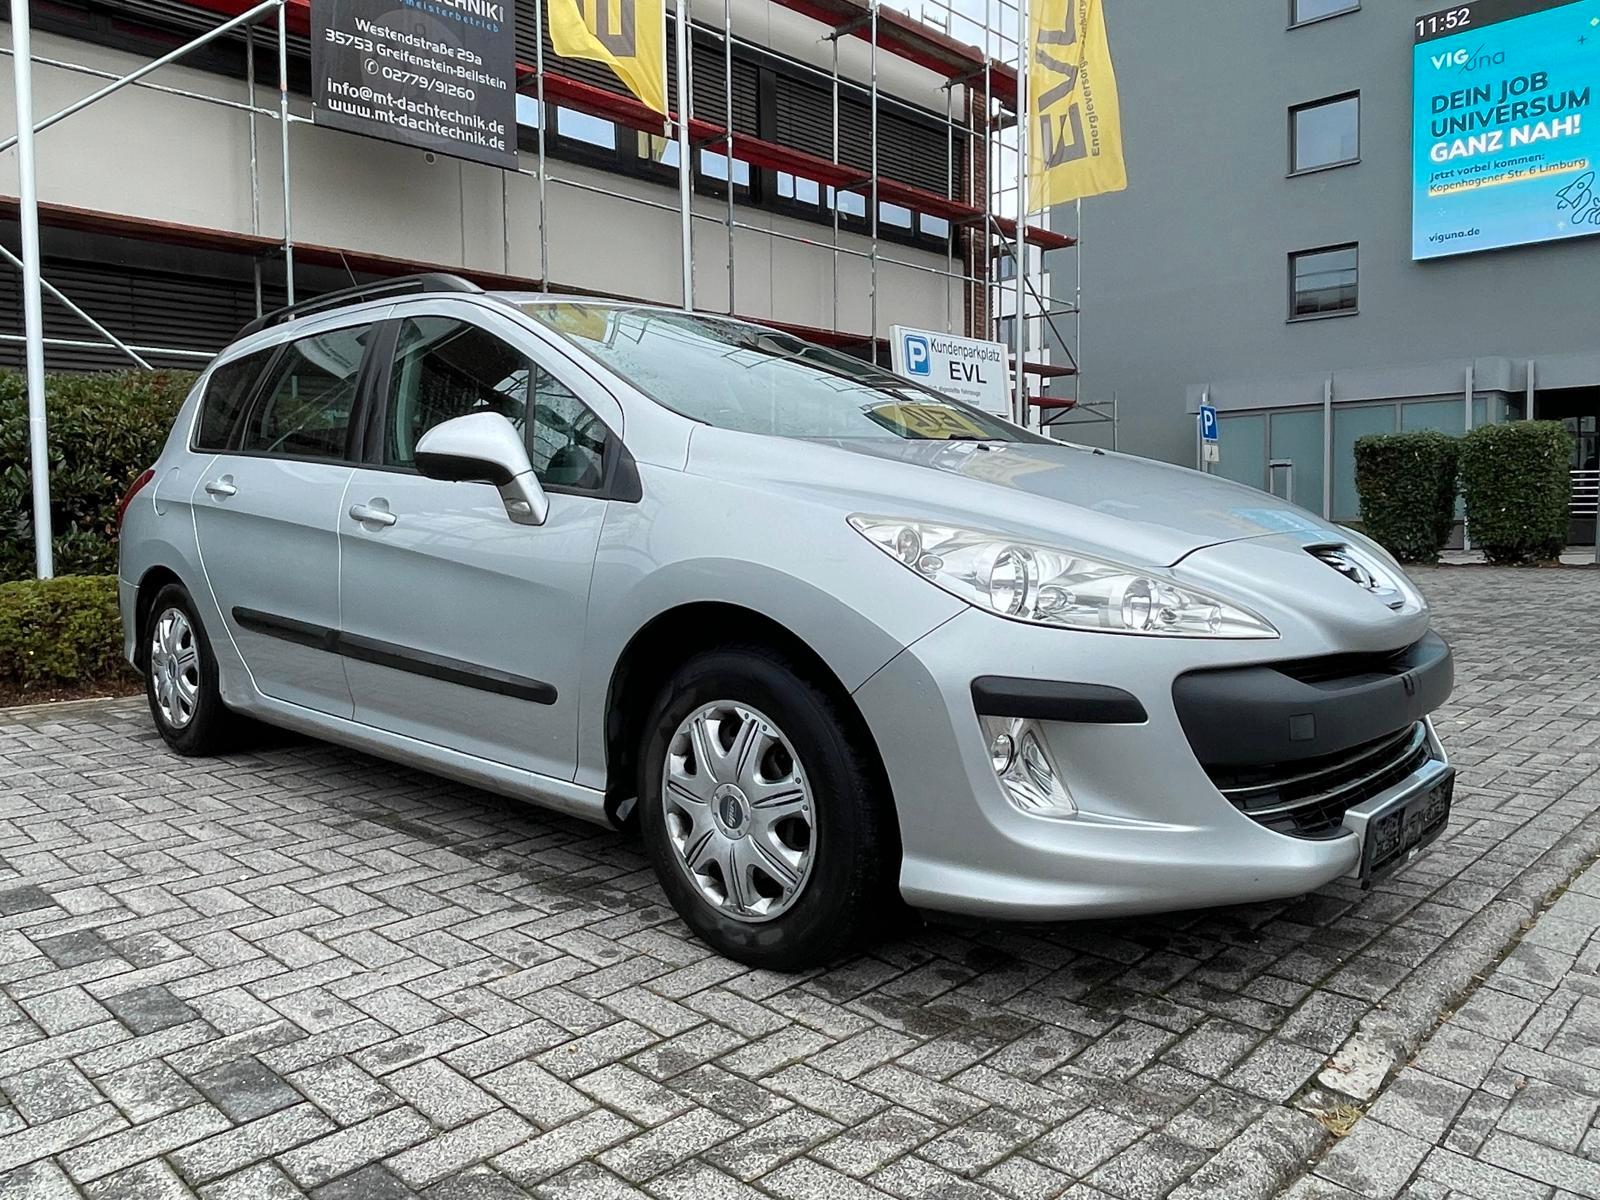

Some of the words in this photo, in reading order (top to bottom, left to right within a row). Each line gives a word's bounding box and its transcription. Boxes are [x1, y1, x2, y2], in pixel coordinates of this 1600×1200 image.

[1415, 7, 1471, 37] 11:52
[325, 28, 374, 52] 35753
[376, 43, 507, 90] Greifenstein-Beilstein
[354, 17, 455, 57] Westendstraße
[456, 47, 483, 66] 29a
[382, 66, 475, 100] 02779/91260
[1431, 84, 1491, 114] DEIN
[1497, 71, 1549, 104] JOB
[327, 77, 505, 135] info@mt-dachtechnik.de
[327, 98, 505, 150] www.mt-dachtechnik.de
[1431, 86, 1591, 138] UNIVERSUM
[1430, 130, 1504, 162] GANZ
[1510, 113, 1582, 147] NAH!
[1429, 174, 1505, 194] Kopenhagener
[1508, 168, 1526, 179] Str.
[1529, 165, 1537, 175] 6
[1539, 157, 1586, 174] Limburg
[1457, 161, 1491, 176] vorbei
[1494, 153, 1546, 169] kommen:
[1428, 227, 1480, 243] viguna.de
[907, 340, 927, 370] P
[930, 338, 1001, 362] Kundenparkplatz
[949, 360, 987, 384] EVL
[1203, 410, 1214, 435] P
